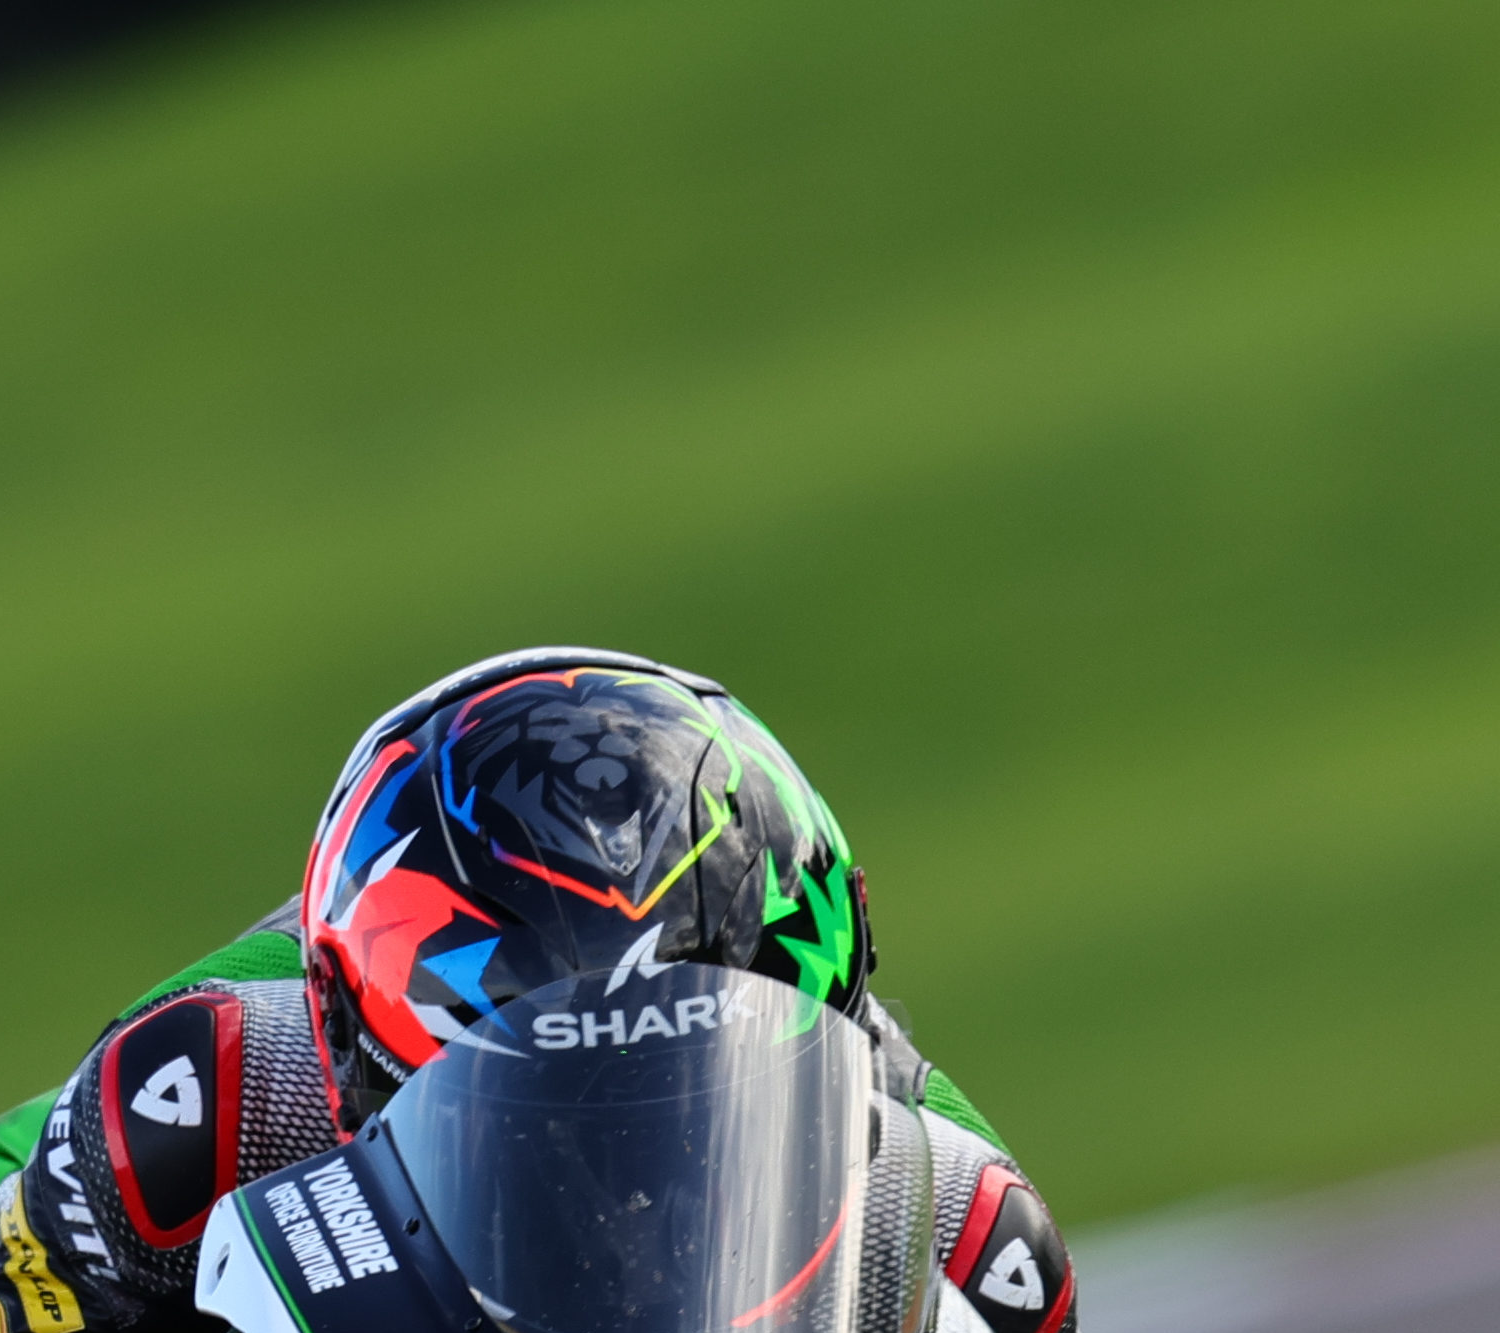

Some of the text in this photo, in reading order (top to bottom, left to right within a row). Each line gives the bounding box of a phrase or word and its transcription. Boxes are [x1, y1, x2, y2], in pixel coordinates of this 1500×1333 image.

[533, 981, 762, 1051] SHARK
[263, 1179, 346, 1294] OFFICE FURNITURE
[302, 1155, 399, 1280] YORKSHIRE
